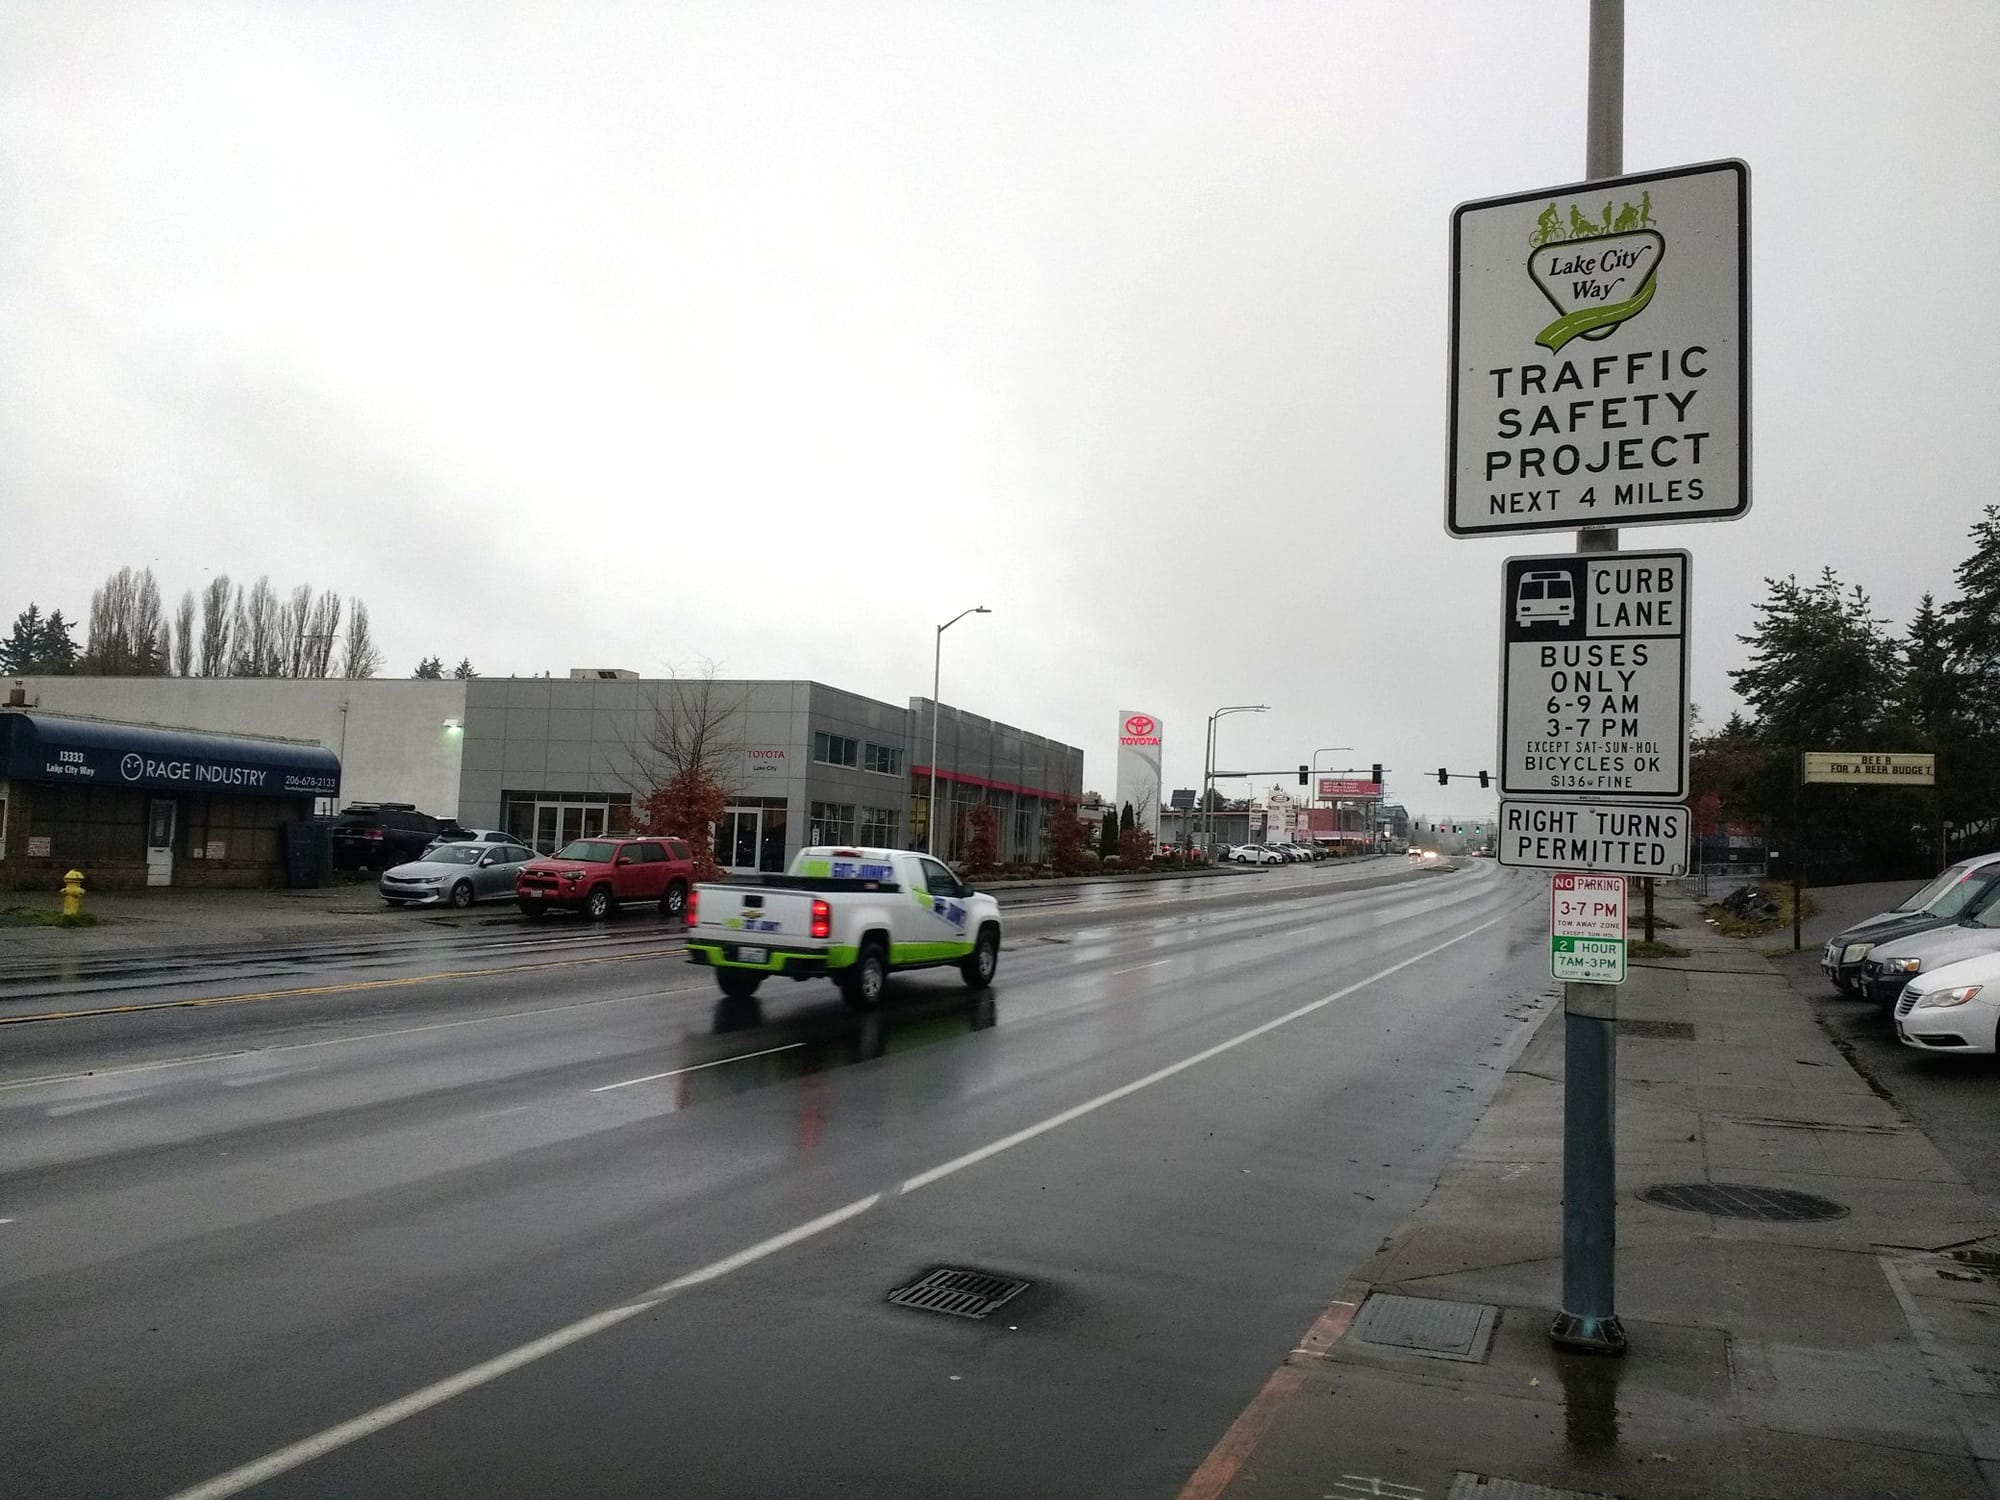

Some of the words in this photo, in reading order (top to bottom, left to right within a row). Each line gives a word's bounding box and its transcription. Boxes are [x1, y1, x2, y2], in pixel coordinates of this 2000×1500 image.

[1549, 255, 1597, 276] Lake
[1600, 245, 1652, 272] City
[1572, 277, 1625, 301] Way
[1489, 346, 1708, 398] TRAFFIC
[1497, 390, 1697, 439] SAFETY
[1486, 433, 1709, 481] PROJECT
[1490, 489, 1560, 515] NEXT
[1579, 487, 1596, 508] 4
[1615, 478, 1704, 505] MILES
[1595, 568, 1674, 595] CURB
[1596, 601, 1673, 628] LANE
[1541, 644, 1649, 667] BUSES
[1551, 670, 1636, 693] ONLY
[1547, 695, 1591, 714] 6-9
[1601, 695, 1639, 714] AM
[1547, 718, 1591, 737] 3-7
[1602, 718, 1639, 737] PM
[1120, 736, 1159, 746] TOYOTA
[1527, 741, 1569, 753] EXCEPT
[1576, 741, 1659, 754] SAT-SUN-HOL
[60, 751, 84, 763] 13333
[747, 750, 785, 759] TOYOTA
[1525, 756, 1624, 771] BICYCLES
[1634, 757, 1660, 772] OK
[46, 763, 64, 774] Lake
[64, 765, 78, 776] City
[80, 766, 95, 777] Way
[146, 760, 191, 780] RAGE
[195, 764, 267, 786] INDUSTRY
[1831, 765, 1848, 773] FOR
[1865, 766, 1888, 774] BEER
[1892, 766, 1931, 774] BUDGET
[285, 775, 336, 788] 206-678-2133
[1550, 775, 1585, 787] $136
[1598, 776, 1633, 788] FINE
[1508, 809, 1578, 833] RIGHT
[1596, 812, 1678, 839] TURNS
[1518, 836, 1666, 865] PERMITTED
[1555, 878, 1573, 889] NO
[1577, 878, 1620, 892] PARKING
[1560, 901, 1587, 916] 3-7
[1593, 902, 1617, 917] PM
[1576, 920, 1596, 928] AWAY
[1600, 921, 1620, 929] ZONE
[1559, 940, 1568, 951] 2
[1582, 943, 1616, 954] HOUR
